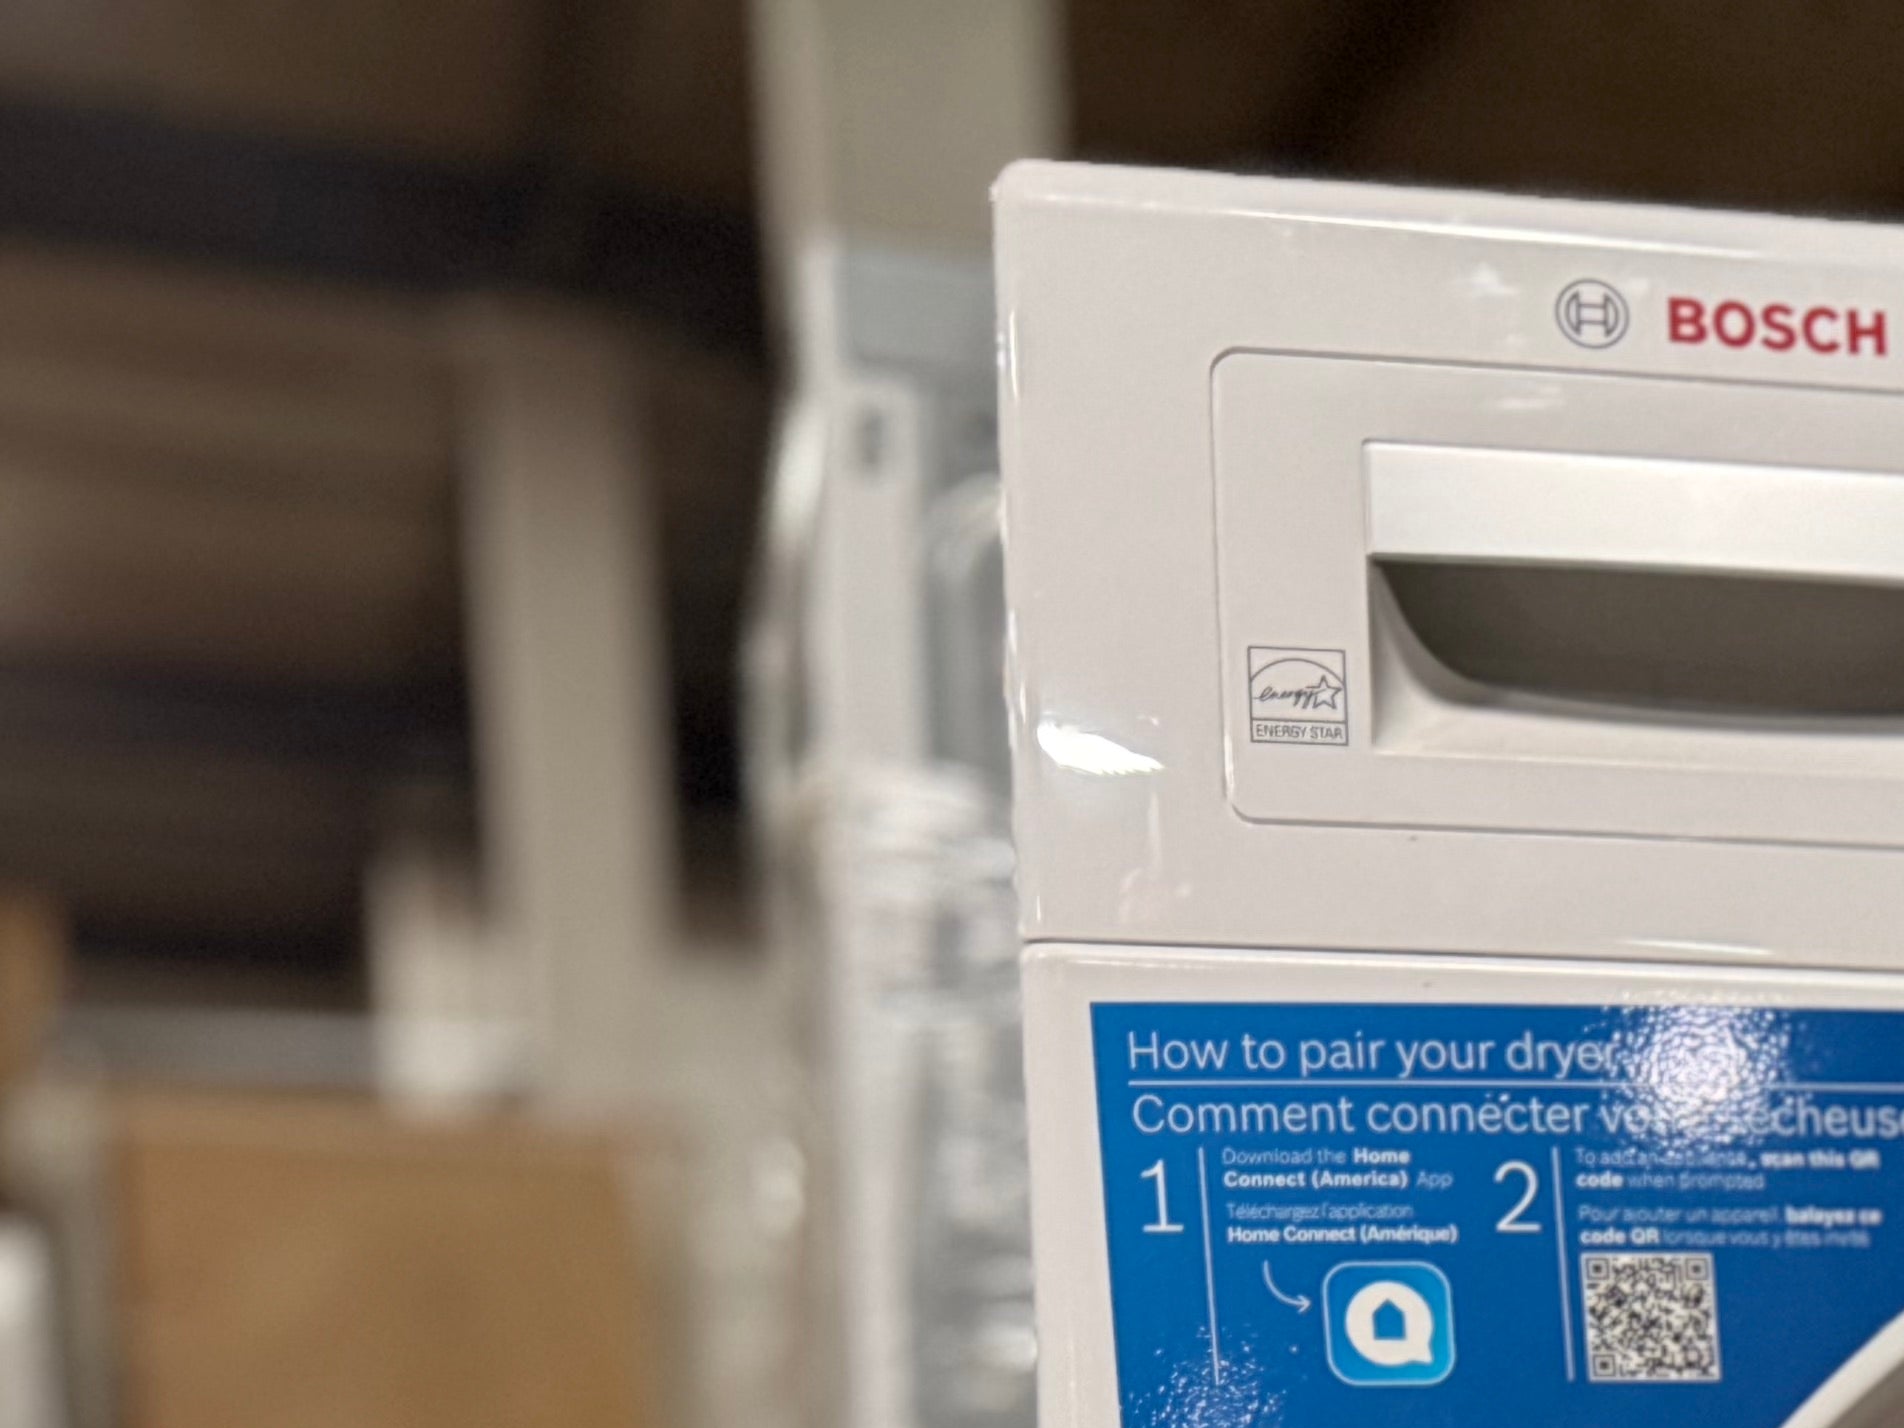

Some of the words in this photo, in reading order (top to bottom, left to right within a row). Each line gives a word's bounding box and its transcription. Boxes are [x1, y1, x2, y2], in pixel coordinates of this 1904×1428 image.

[1668, 297, 1887, 356] BOSCH
[1256, 724, 1307, 738] ENERGY
[1310, 725, 1343, 739] STAR
[1128, 1030, 1229, 1071] How
[1242, 1033, 1286, 1071] to
[1300, 1030, 1386, 1077] pair
[1395, 1038, 1496, 1079] your
[1132, 1094, 1356, 1134] Comment
[1367, 1096, 1590, 1135] connecter
[1222, 1147, 1312, 1165] Download
[1317, 1147, 1346, 1165] the
[1353, 1148, 1411, 1165] Home
[1224, 1171, 1305, 1188] Connect
[1312, 1170, 1408, 1190] (America)
[1417, 1171, 1453, 1190] App
[1576, 1170, 1623, 1188] code
[1140, 1159, 1185, 1233] 1
[1494, 1160, 1542, 1233] 2
[1228, 1226, 1280, 1243] Home
[1283, 1226, 1356, 1243] Connect
[1360, 1225, 1458, 1246] (Amérique)
[1580, 1227, 1626, 1244] code
